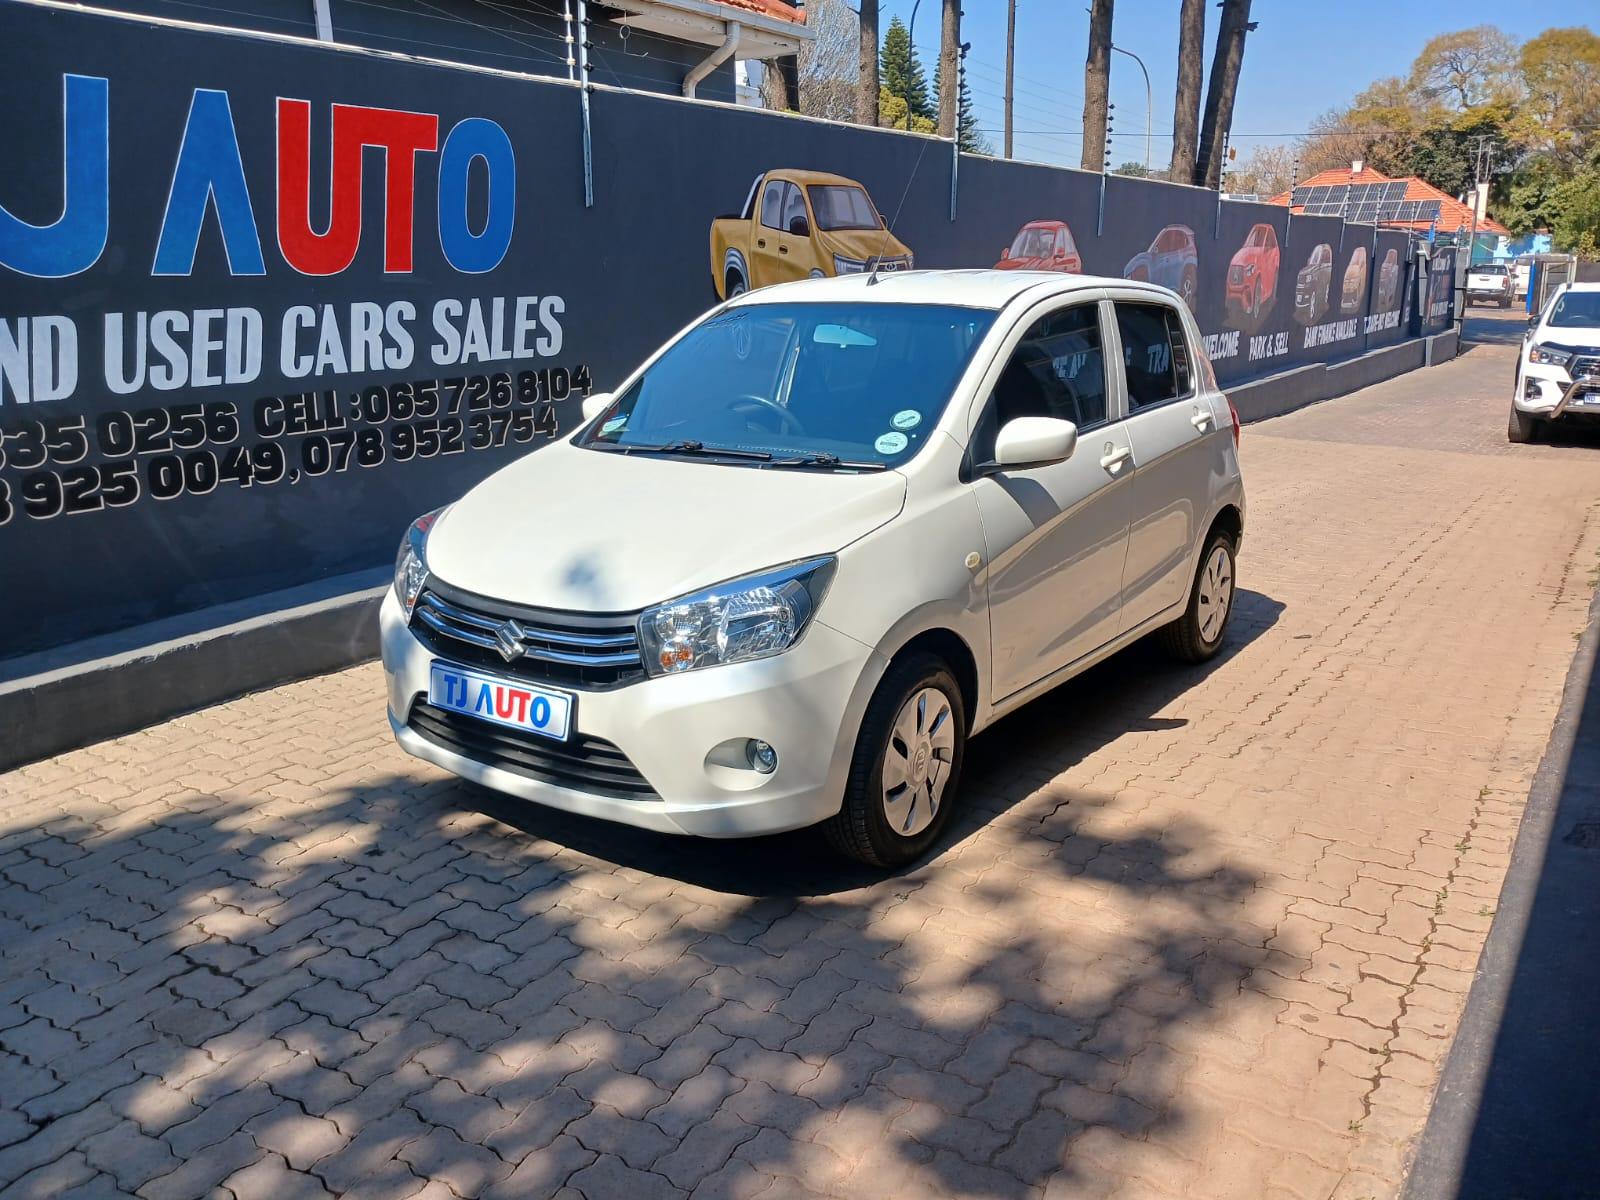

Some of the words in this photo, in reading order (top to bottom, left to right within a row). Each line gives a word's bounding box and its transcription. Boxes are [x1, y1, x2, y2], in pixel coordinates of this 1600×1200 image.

[151, 88, 516, 277] AUTO
[104, 307, 263, 394] USED
[280, 300, 417, 379] CARS
[431, 295, 566, 366] SALES
[1203, 331, 1240, 361] WELCOME
[1249, 336, 1267, 361] PARK
[1274, 332, 1289, 356] SELL
[0, 415, 88, 470] 35
[97, 401, 240, 457] 0256
[446, 371, 512, 415] 726
[517, 365, 593, 406] 8104
[21, 459, 140, 520] 925
[392, 418, 465, 462] 952
[470, 405, 559, 450] 3754
[444, 674, 468, 708] TJ
[475, 683, 551, 729] AUTO
